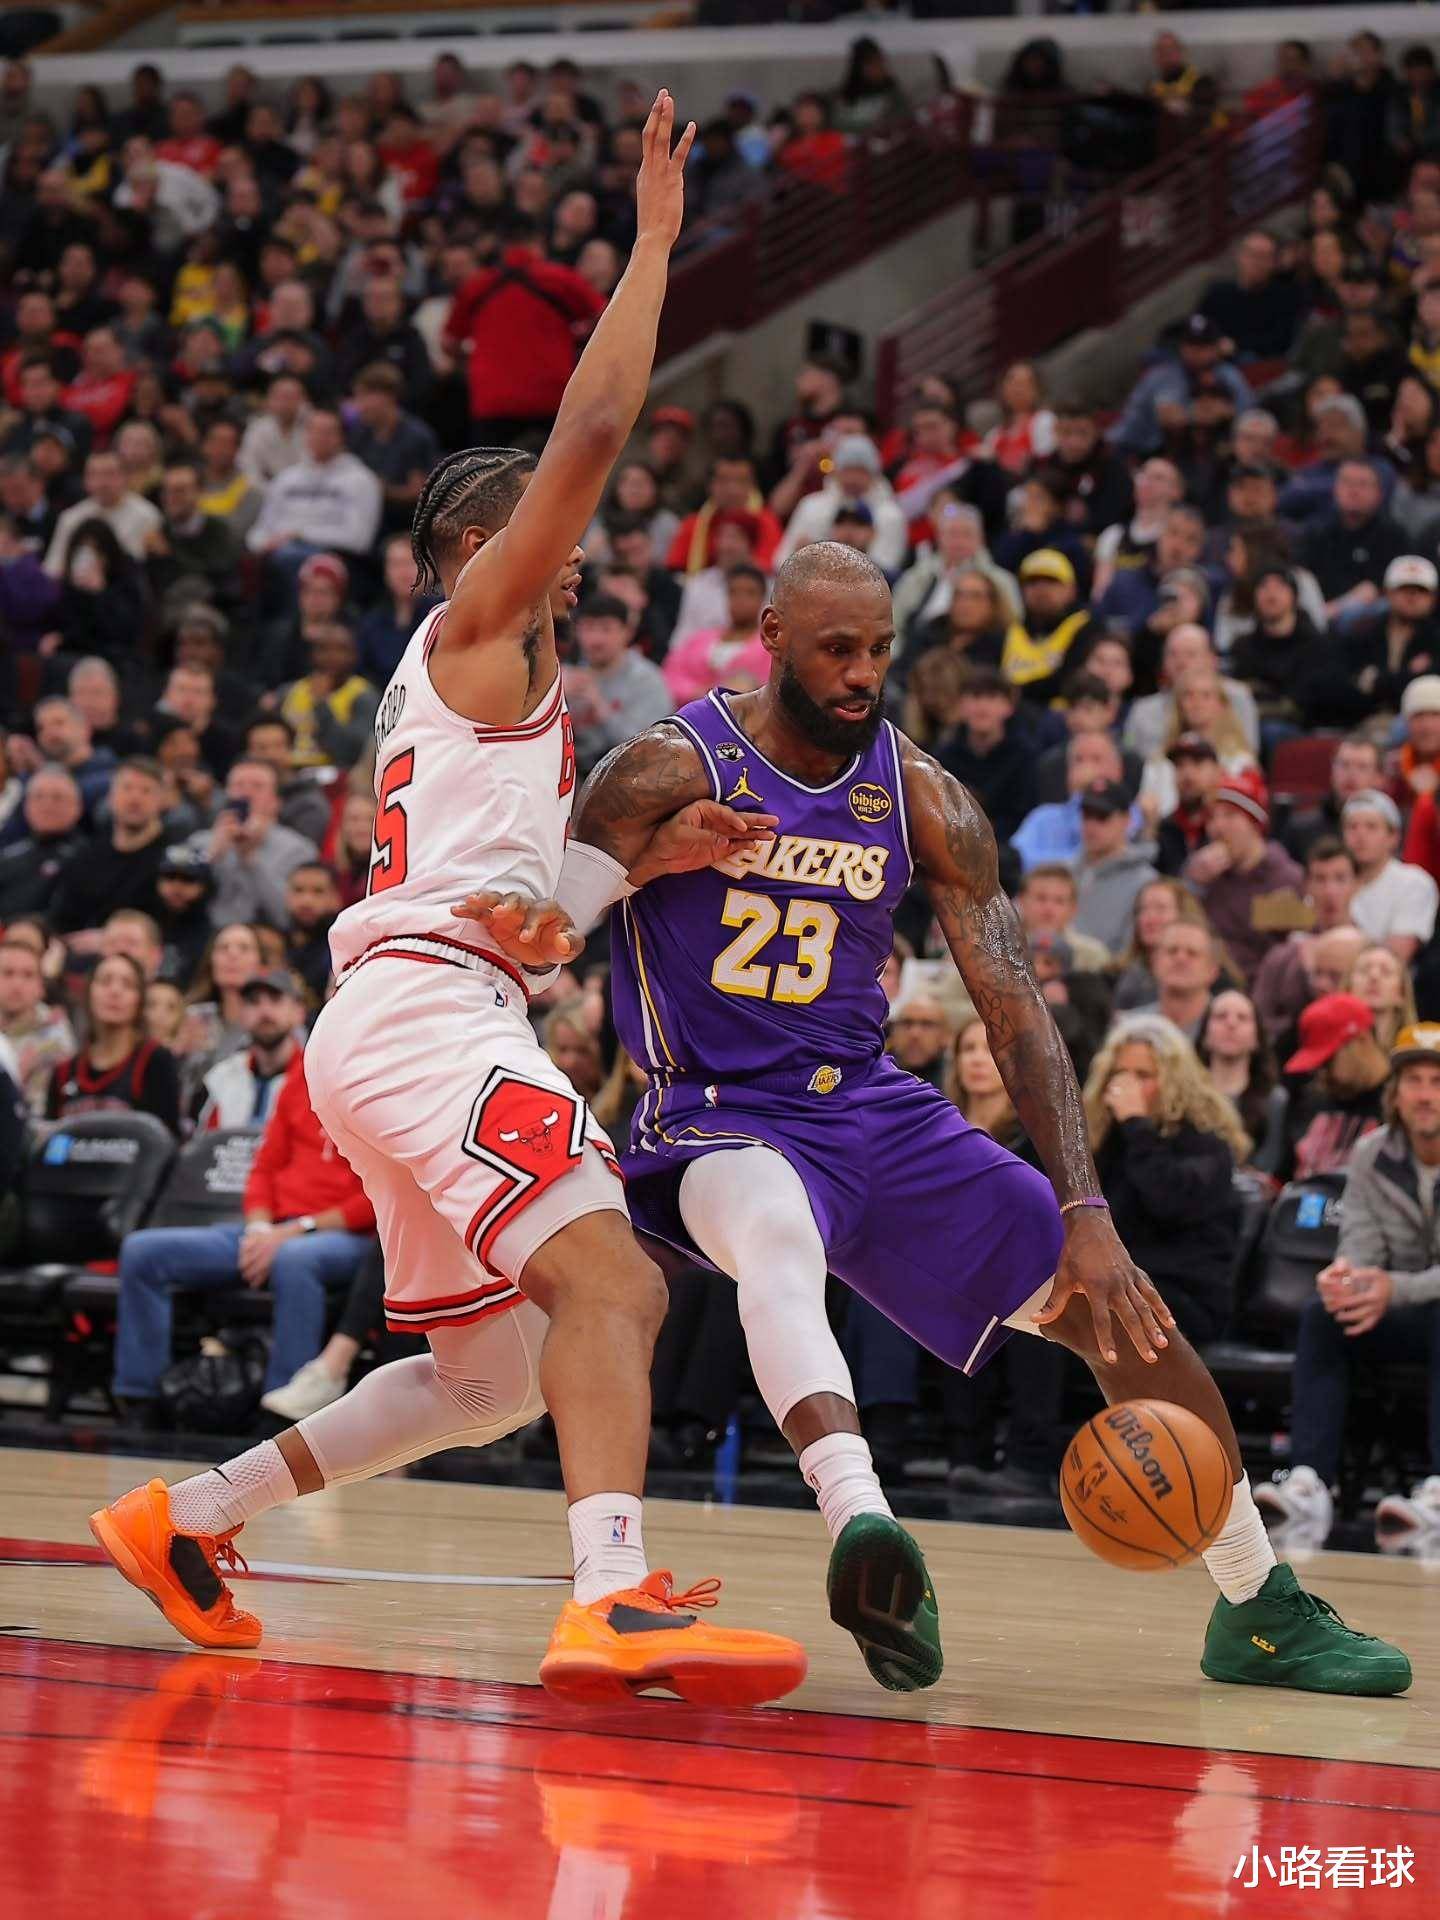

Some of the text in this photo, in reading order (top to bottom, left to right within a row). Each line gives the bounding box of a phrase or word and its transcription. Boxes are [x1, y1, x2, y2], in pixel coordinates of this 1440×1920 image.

[852, 792, 889, 812] bibigo
[711, 887, 841, 1004] 23
[1104, 1407, 1174, 1501] Wilson
